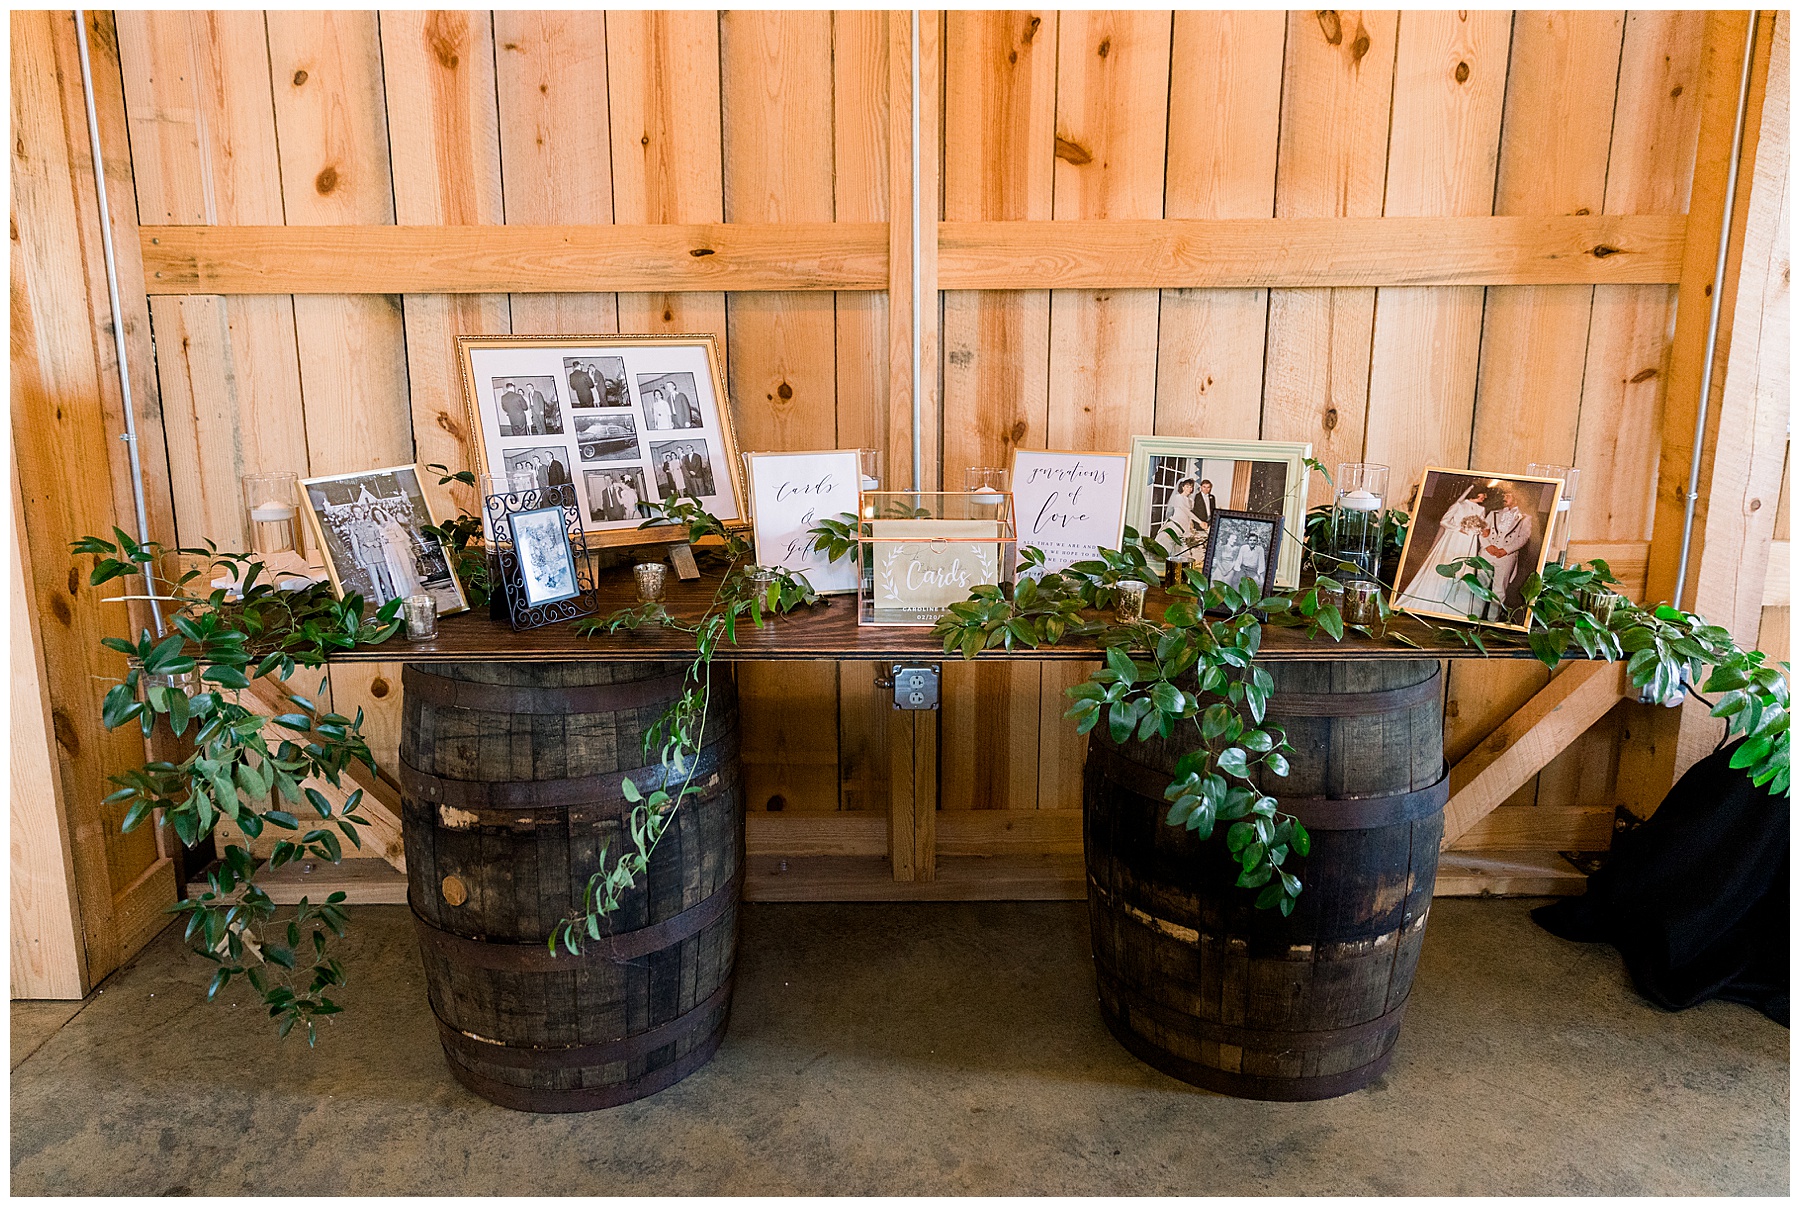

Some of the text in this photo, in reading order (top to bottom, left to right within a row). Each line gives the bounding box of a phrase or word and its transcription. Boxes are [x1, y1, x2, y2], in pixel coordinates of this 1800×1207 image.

[1027, 461, 1108, 485] generations
[772, 473, 839, 503] Cards
[1068, 486, 1083, 506] of
[800, 507, 816, 528] &
[1033, 491, 1090, 535] love
[906, 558, 972, 591] Cards
